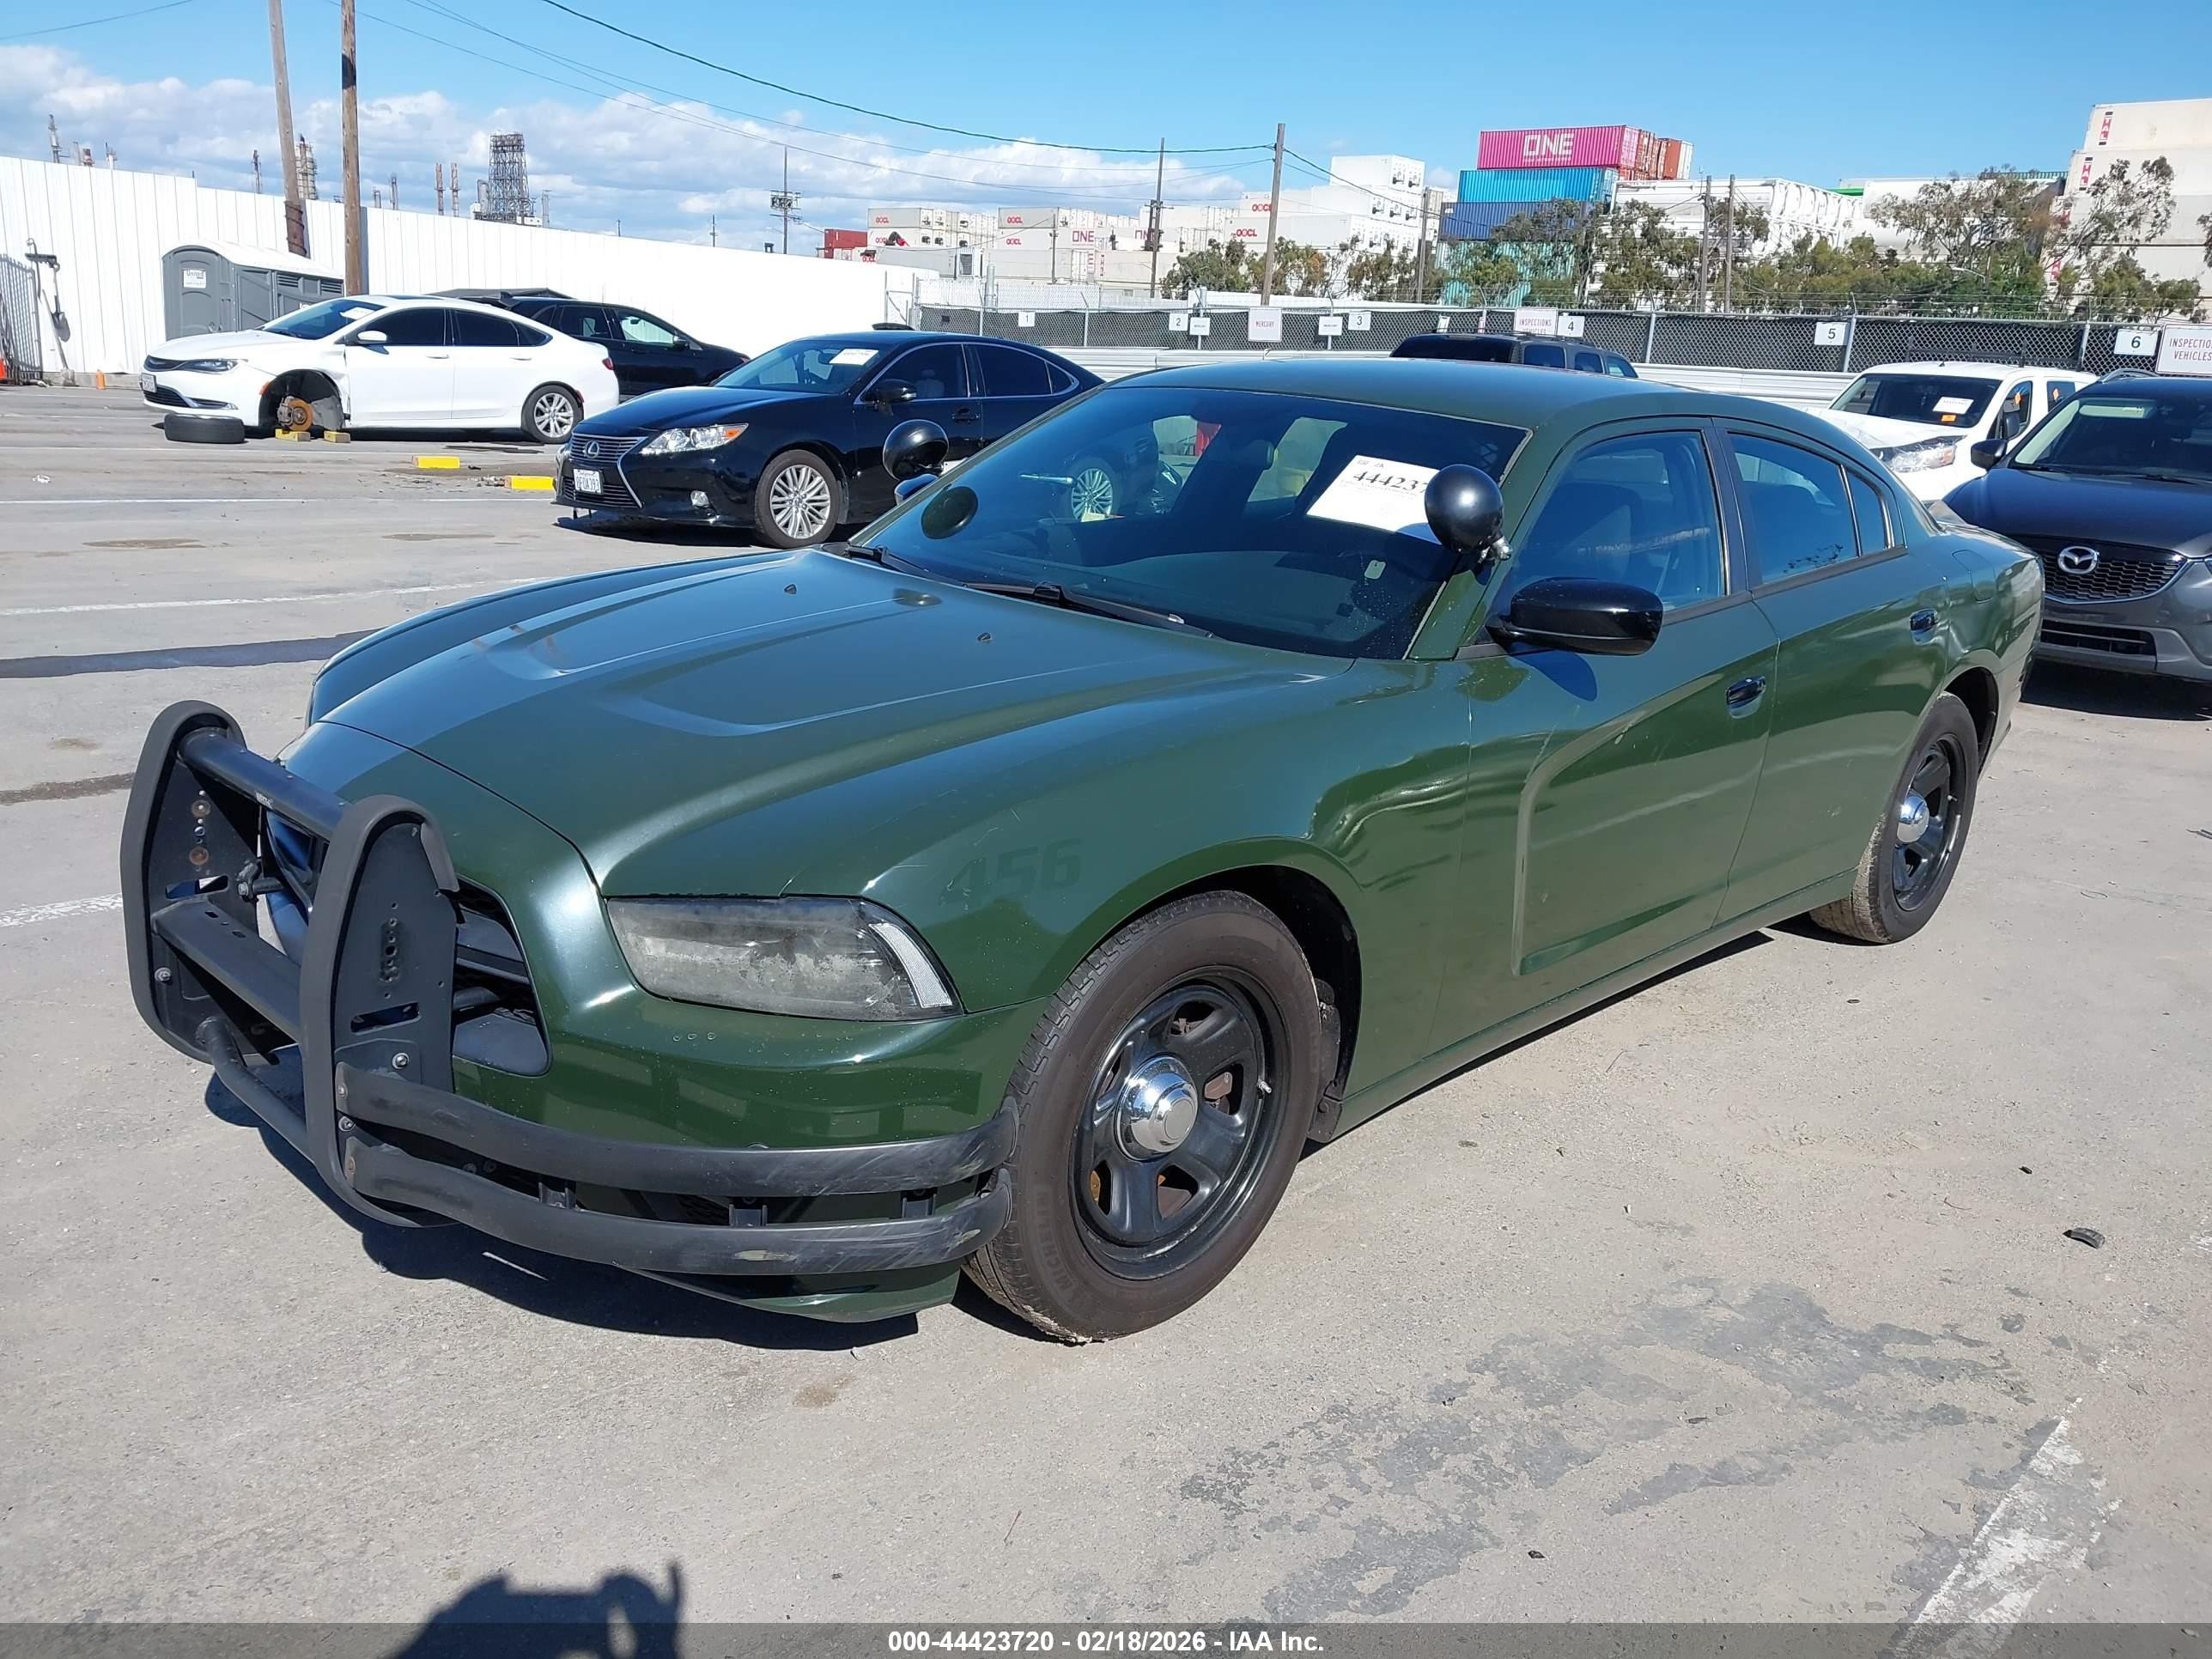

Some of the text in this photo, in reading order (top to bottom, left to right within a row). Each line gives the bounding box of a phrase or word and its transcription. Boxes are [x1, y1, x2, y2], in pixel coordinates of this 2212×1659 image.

[1523, 133, 1574, 155] ONE
[1073, 230, 1094, 242] ONE
[1237, 228, 1258, 237] OOCL
[1176, 317, 1181, 326] 2
[1357, 315, 1363, 325] 3
[1519, 319, 1552, 327] INSPECTIONS
[1567, 321, 1575, 331] 4
[1827, 327, 1837, 340] 5
[2130, 336, 2142, 349] 6
[2173, 350, 2212, 362] VEHICLES
[939, 838, 1082, 908] 456
